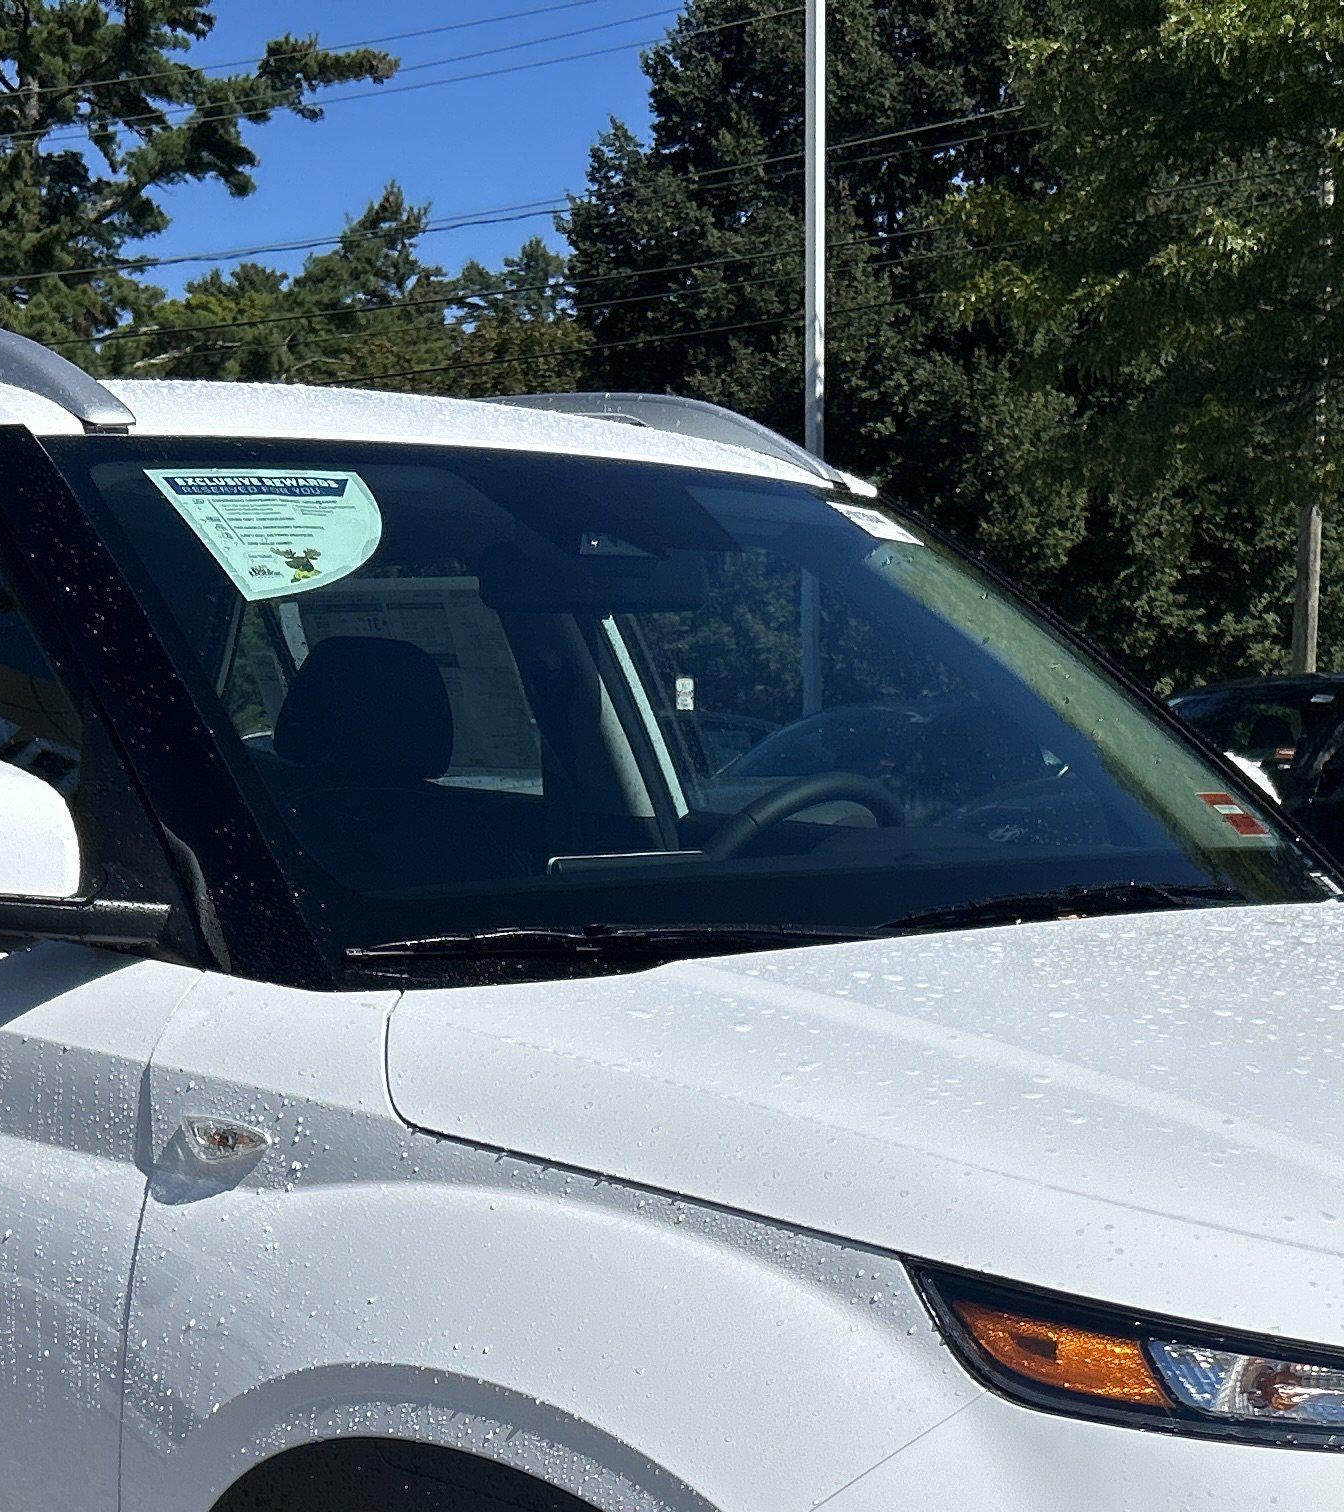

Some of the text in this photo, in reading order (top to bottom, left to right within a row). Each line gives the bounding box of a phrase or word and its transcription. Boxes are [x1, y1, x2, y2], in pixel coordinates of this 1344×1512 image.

[174, 477, 339, 488] EXCLUSIVE REWARDS
[182, 486, 257, 494] RESERVED
[261, 486, 289, 494] FOR
